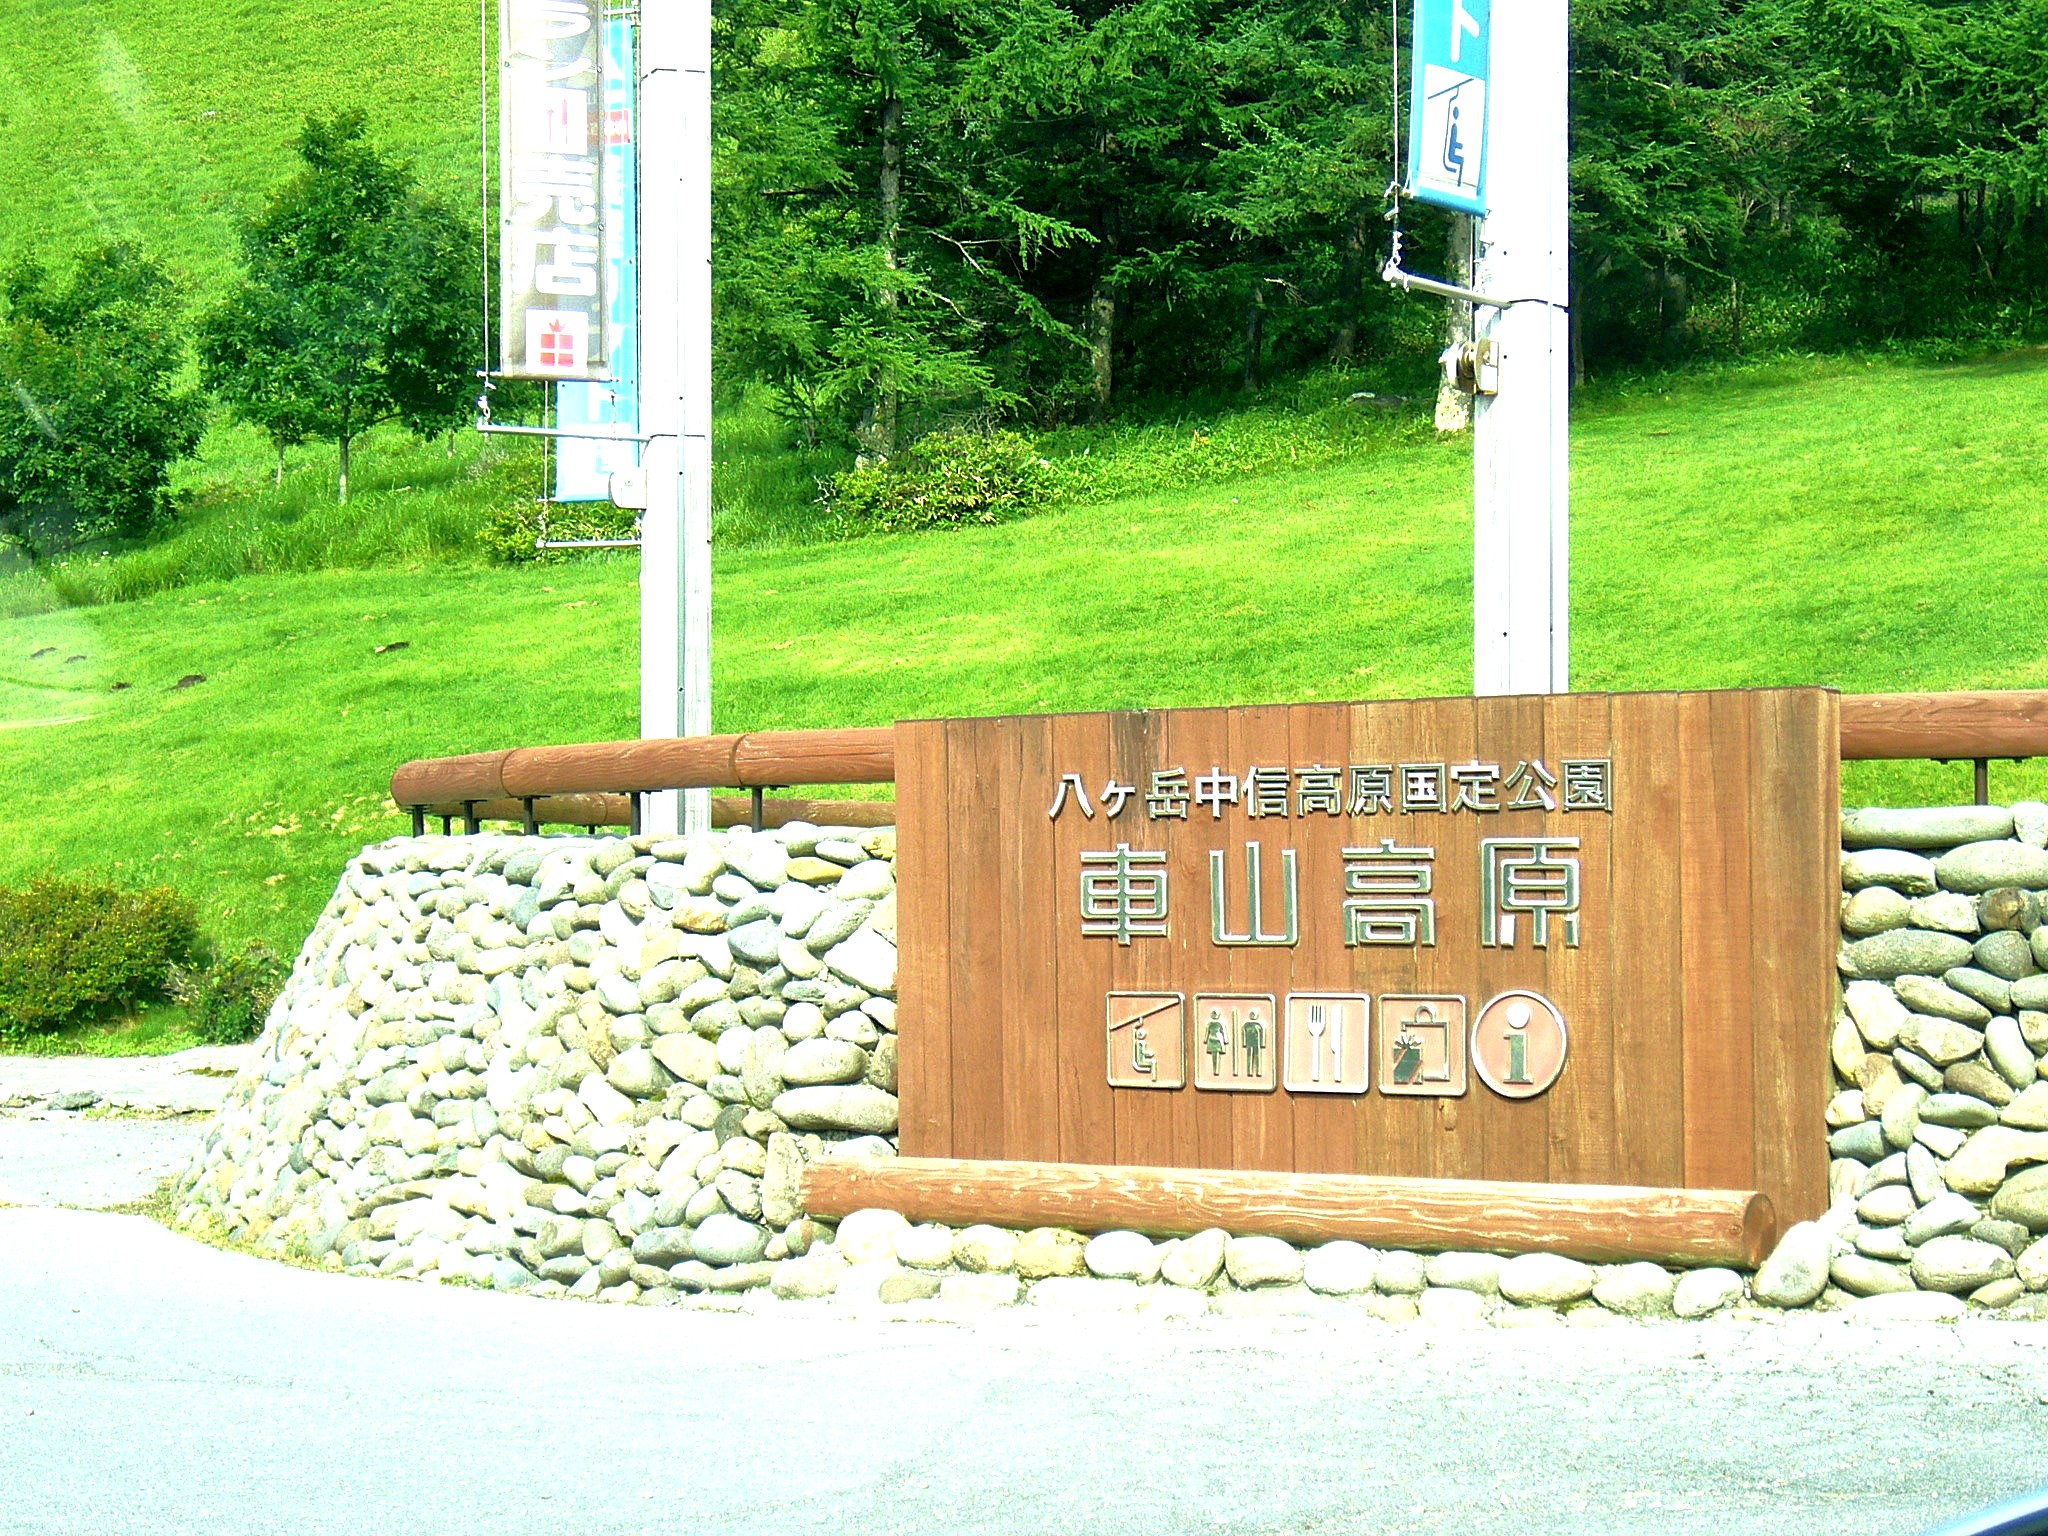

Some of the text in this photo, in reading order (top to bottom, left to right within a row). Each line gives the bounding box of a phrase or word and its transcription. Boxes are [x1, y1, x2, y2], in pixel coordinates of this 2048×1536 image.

[511, 153, 598, 297] 売店
[1080, 838, 1581, 948] 車山高原
